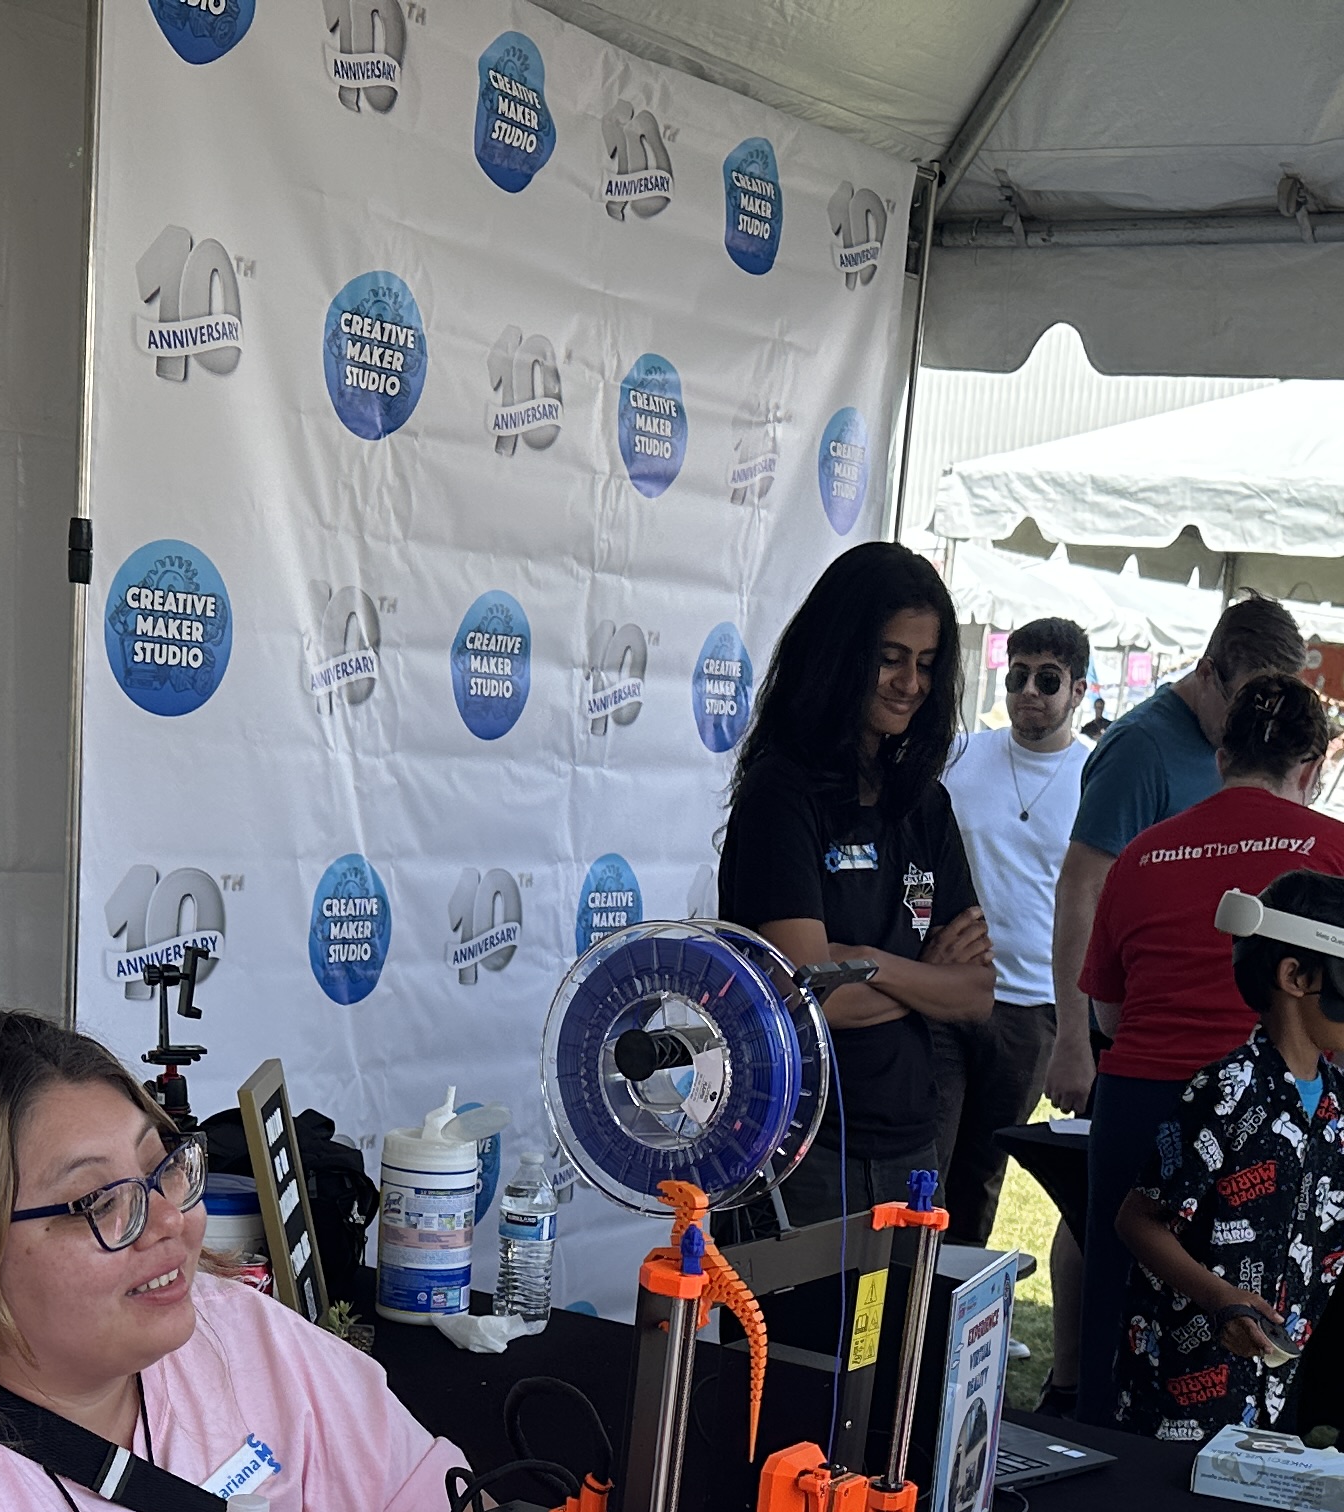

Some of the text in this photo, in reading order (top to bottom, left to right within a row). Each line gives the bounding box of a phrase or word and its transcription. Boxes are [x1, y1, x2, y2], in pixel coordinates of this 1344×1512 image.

[333, 57, 397, 82] ANNIVERSARY
[489, 69, 542, 110] CREATIVE
[497, 96, 539, 132] MAKER
[491, 119, 537, 154] STUDIO
[605, 173, 671, 197] ANNIVERSARY
[732, 170, 776, 201] CREATIVE
[740, 193, 772, 220] MAKER
[738, 212, 770, 240] STUDIO
[147, 320, 240, 350] ANNIVERSARY
[340, 311, 416, 350] CREATIVE
[346, 339, 405, 373] MAKER
[345, 366, 401, 397] STUDIO
[630, 389, 678, 418] CREATIVE
[492, 403, 560, 433] ANNIVERSARY
[635, 411, 672, 438] MAKER
[634, 434, 672, 460] STUDIO
[126, 586, 217, 618] CREATIVE
[136, 614, 204, 643] MAKER
[133, 642, 204, 669] STUDIO
[465, 631, 522, 655] CREATIVE
[310, 655, 376, 691] ANNIVERSARY
[470, 654, 513, 676] MAKER
[703, 658, 743, 678] CREATIVE
[470, 677, 514, 699] STUDIO
[587, 682, 642, 715] ANNIVERSARY
[706, 679, 736, 697] MAKER
[706, 699, 737, 717] STUDIO
[1139, 836, 1303, 867] #UniteTheValley
[322, 898, 379, 917] CREATIVE
[587, 891, 633, 908] CREATIVE
[329, 921, 372, 940] MAKER
[592, 911, 627, 928] MAKER
[328, 942, 372, 963] STUDIO
[452, 925, 518, 966] ANNIVERSARY
[1217, 1159, 1278, 1196] MARIO
[1228, 1180, 1276, 1208] SUPER
[1211, 1228, 1256, 1244] MARIO
[1213, 1218, 1250, 1231] SUPER
[1168, 1364, 1229, 1394] MARIO
[1176, 1383, 1227, 1407] SUPER
[1156, 1427, 1205, 1442] MARIO
[1163, 1418, 1199, 1430] SUPER
[217, 1458, 262, 1499] ariana
